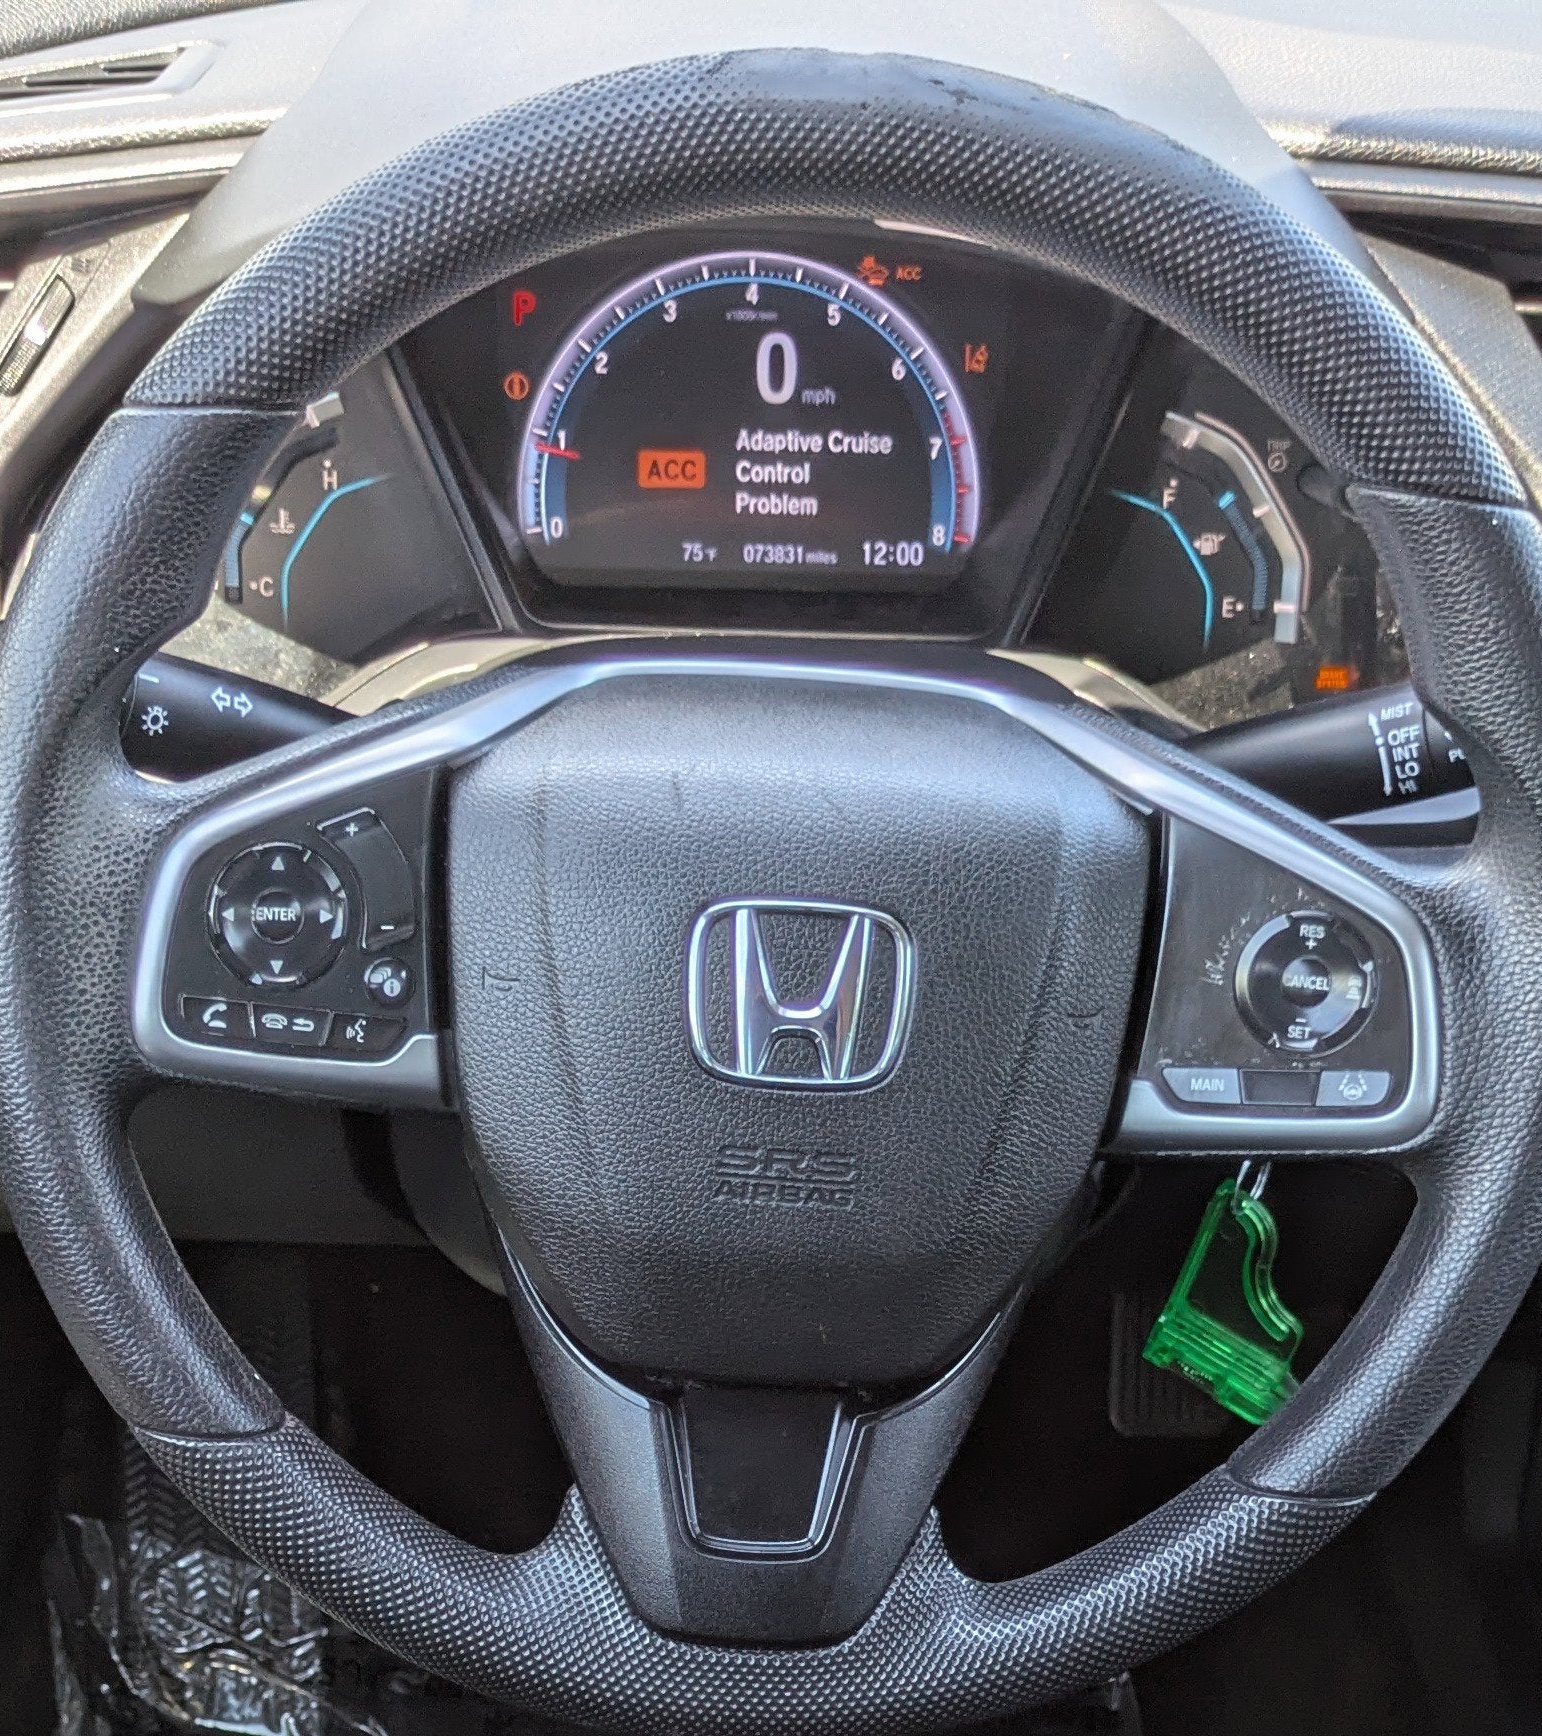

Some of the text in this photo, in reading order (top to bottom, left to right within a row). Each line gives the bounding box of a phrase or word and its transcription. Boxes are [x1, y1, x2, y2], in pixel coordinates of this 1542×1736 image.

[746, 283, 758, 304] 4
[663, 300, 677, 323] 3
[827, 304, 841, 326] 5
[594, 351, 608, 375] 2
[756, 332, 798, 404] 0
[892, 356, 906, 381] 6
[801, 387, 837, 406] mph
[558, 429, 567, 451] 1
[735, 428, 894, 455] Adaptive Cruise
[929, 437, 942, 460] 7
[322, 469, 338, 491] H
[647, 459, 698, 482] ACC
[735, 460, 811, 485] Control
[735, 490, 819, 516] Problem
[1162, 486, 1176, 508] F
[550, 517, 564, 539] 0
[931, 523, 946, 546] 8
[742, 543, 804, 564] 073831
[862, 540, 925, 566] 12:00
[1222, 596, 1235, 618] E
[1380, 701, 1413, 722] MIST
[1387, 724, 1421, 746] OFF
[1391, 742, 1421, 763] INT
[1395, 761, 1420, 779] LO
[254, 906, 297, 922] ENTER
[1299, 924, 1326, 939] RES
[1281, 974, 1330, 991] CANCEL
[1287, 1025, 1312, 1040] SET
[1190, 1078, 1225, 1092] MAIN
[715, 1145, 858, 1184] SRS
[711, 1180, 856, 1212] AIRBAG
